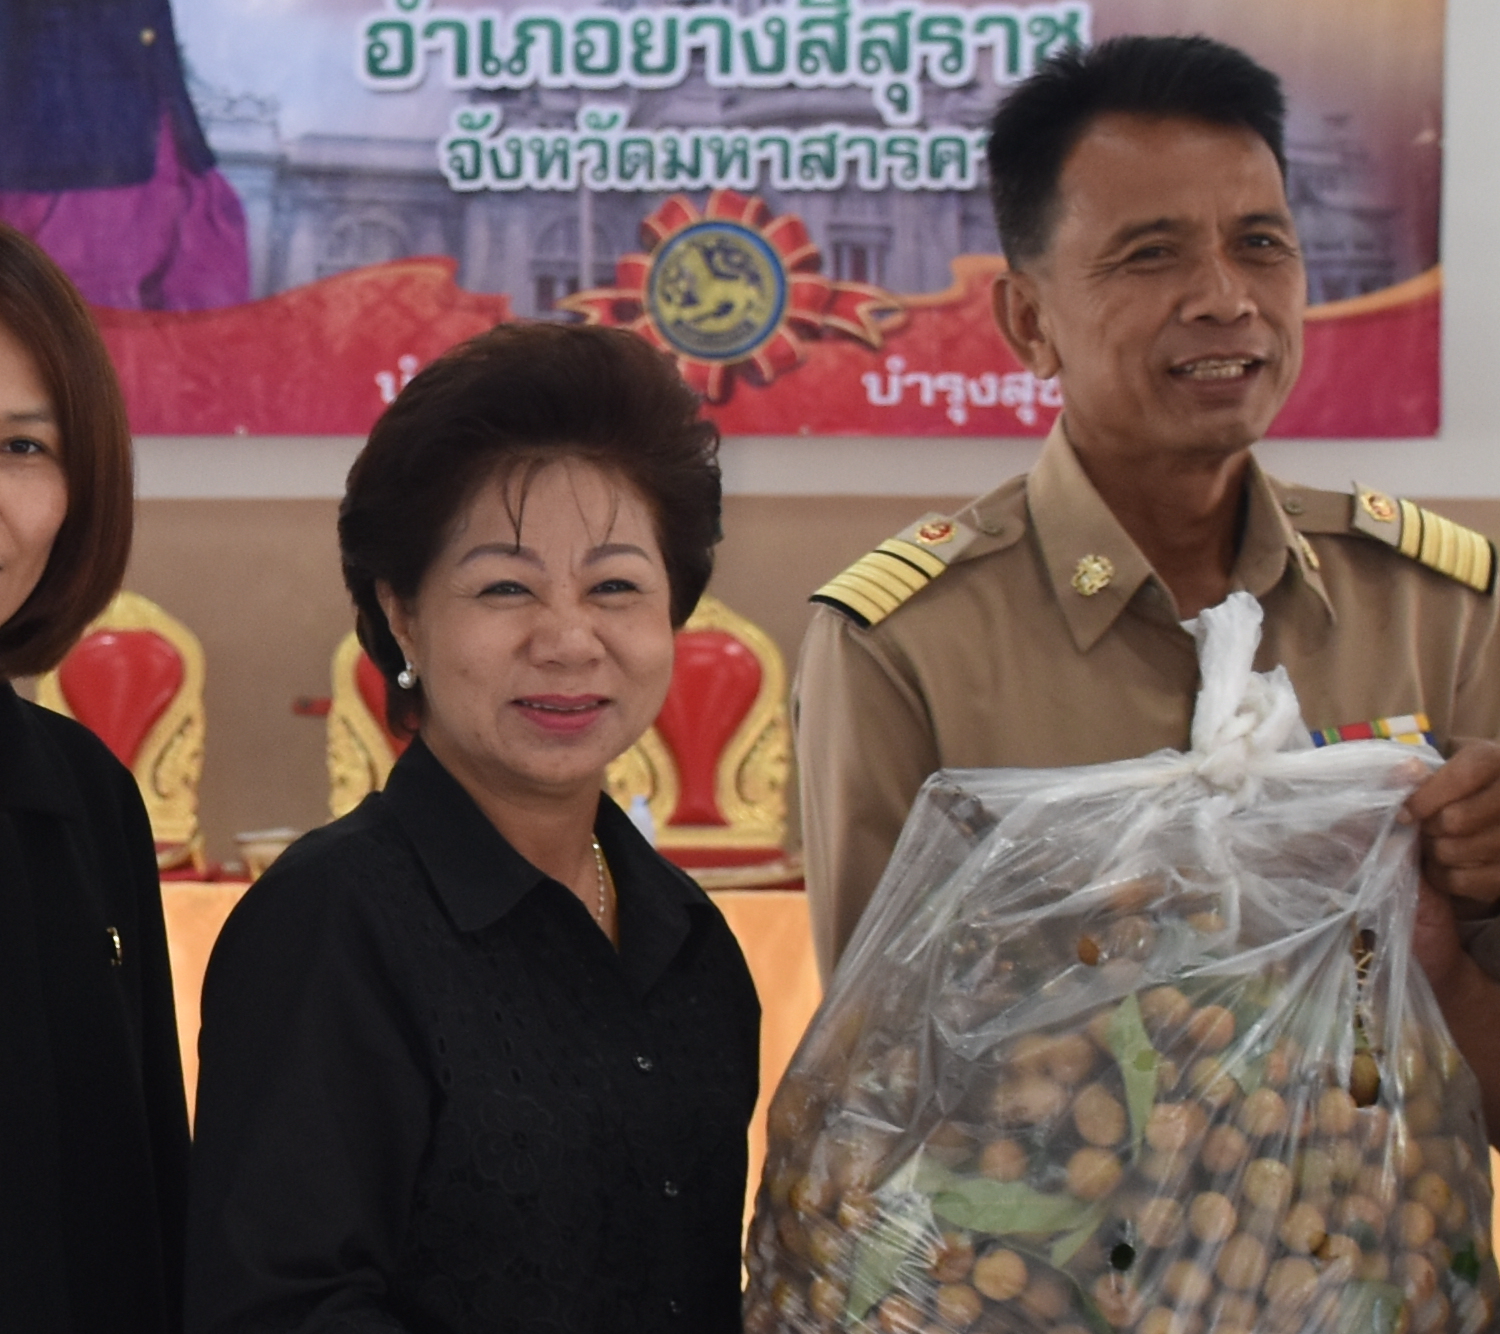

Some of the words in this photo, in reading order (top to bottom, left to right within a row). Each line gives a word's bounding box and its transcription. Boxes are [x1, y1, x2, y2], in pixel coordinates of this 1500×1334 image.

[445, 111, 988, 183] จังหวัดมหาสารค
